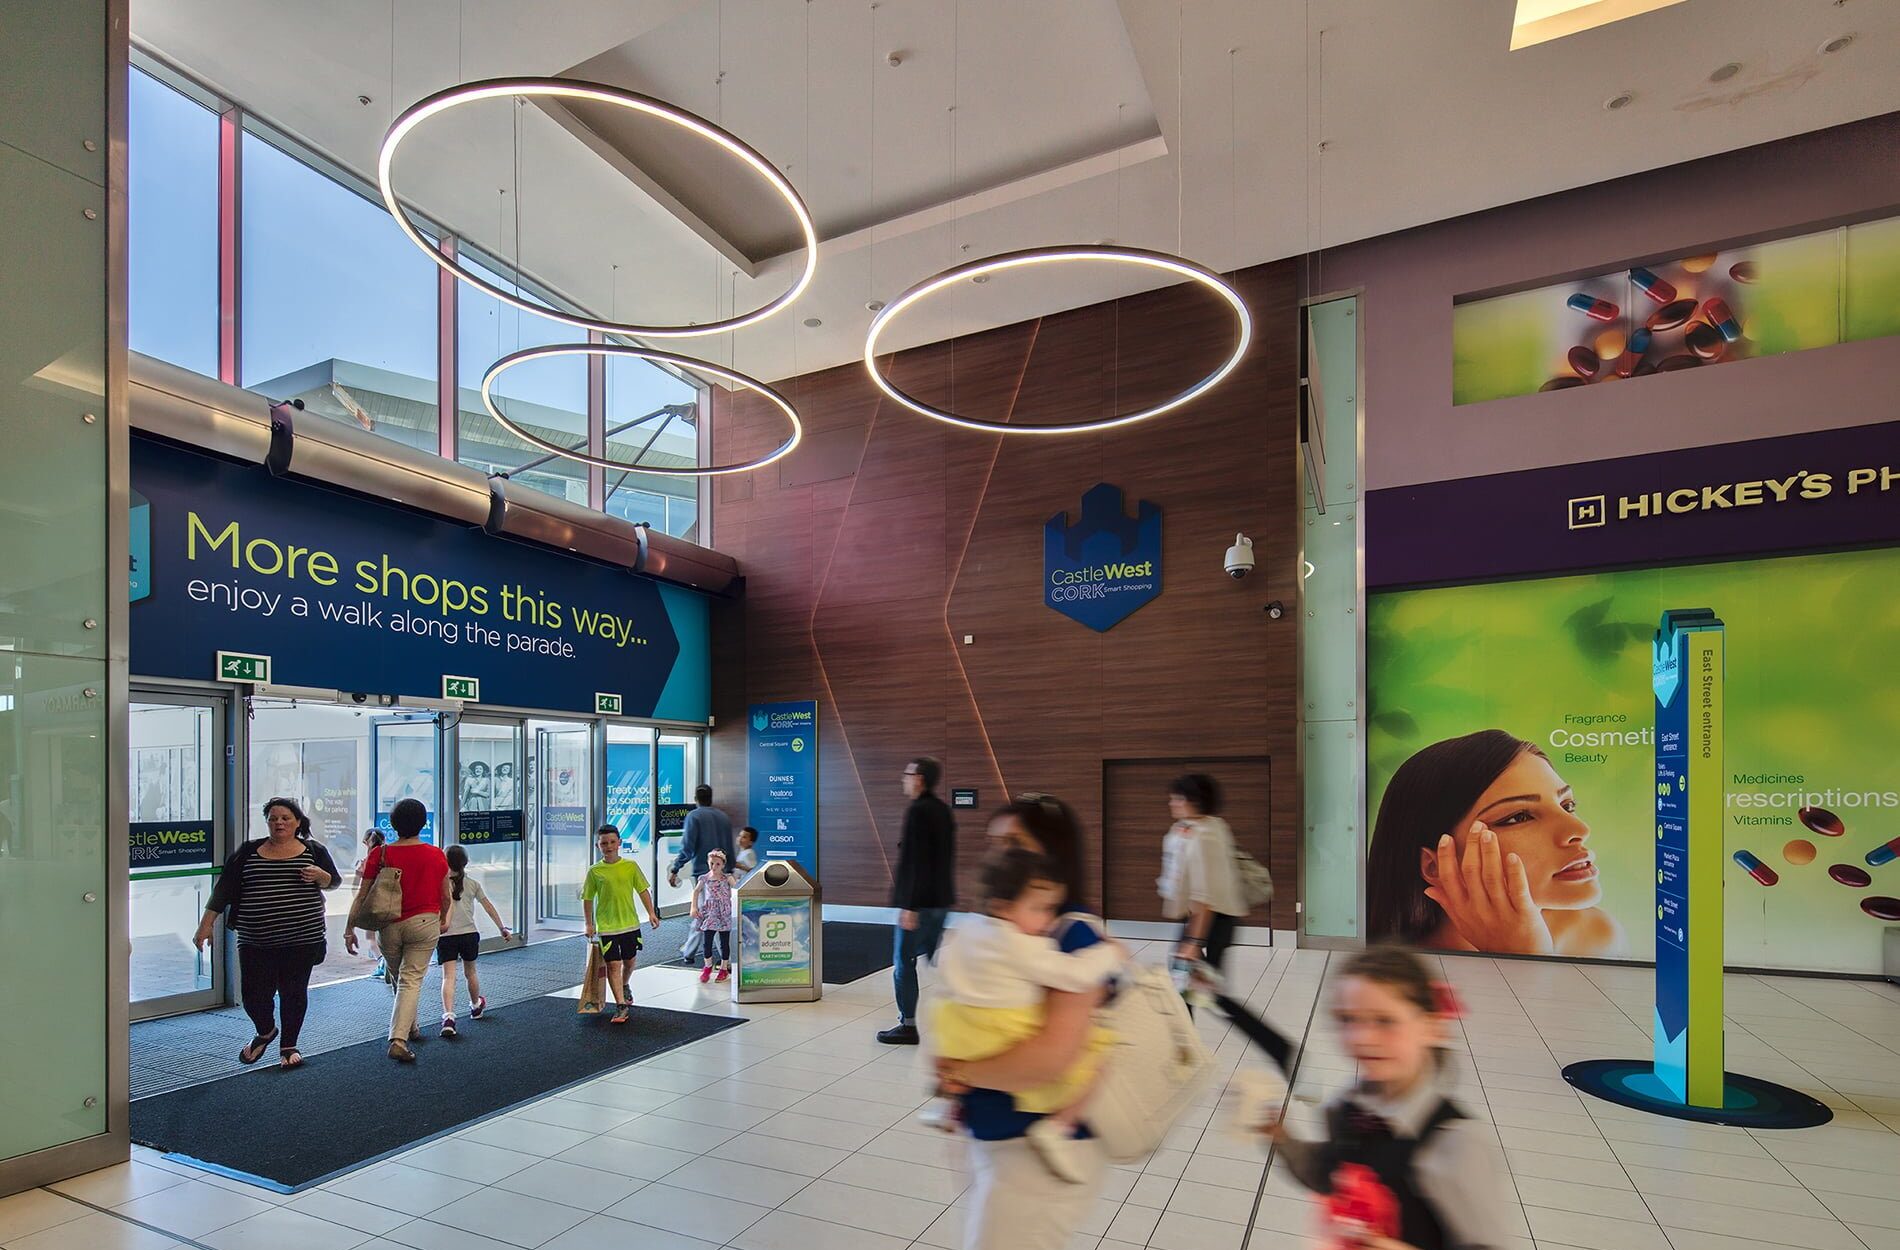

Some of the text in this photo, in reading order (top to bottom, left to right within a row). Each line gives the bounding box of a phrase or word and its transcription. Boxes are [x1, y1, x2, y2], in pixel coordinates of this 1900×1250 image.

[1618, 470, 1833, 520] HICKEY'S
[187, 511, 648, 647] More shops this way...
[1051, 561, 1153, 586] CastleWest
[1051, 583, 1105, 602] CORK
[1123, 583, 1153, 592] Shopping
[187, 579, 576, 659] enjoy a walk along the parade.
[1702, 649, 1713, 759] East Street entrance
[1564, 714, 1627, 725] Fragrance
[1549, 726, 1655, 747] Cosmeti
[1565, 752, 1608, 764] Beauty
[1733, 774, 1804, 784] Medicines
[607, 785, 632, 795] Treat
[1726, 788, 1899, 812] rescriptions
[1734, 814, 1793, 826] Vitamins
[129, 829, 206, 847] stleWest
[128, 846, 160, 861] RK
